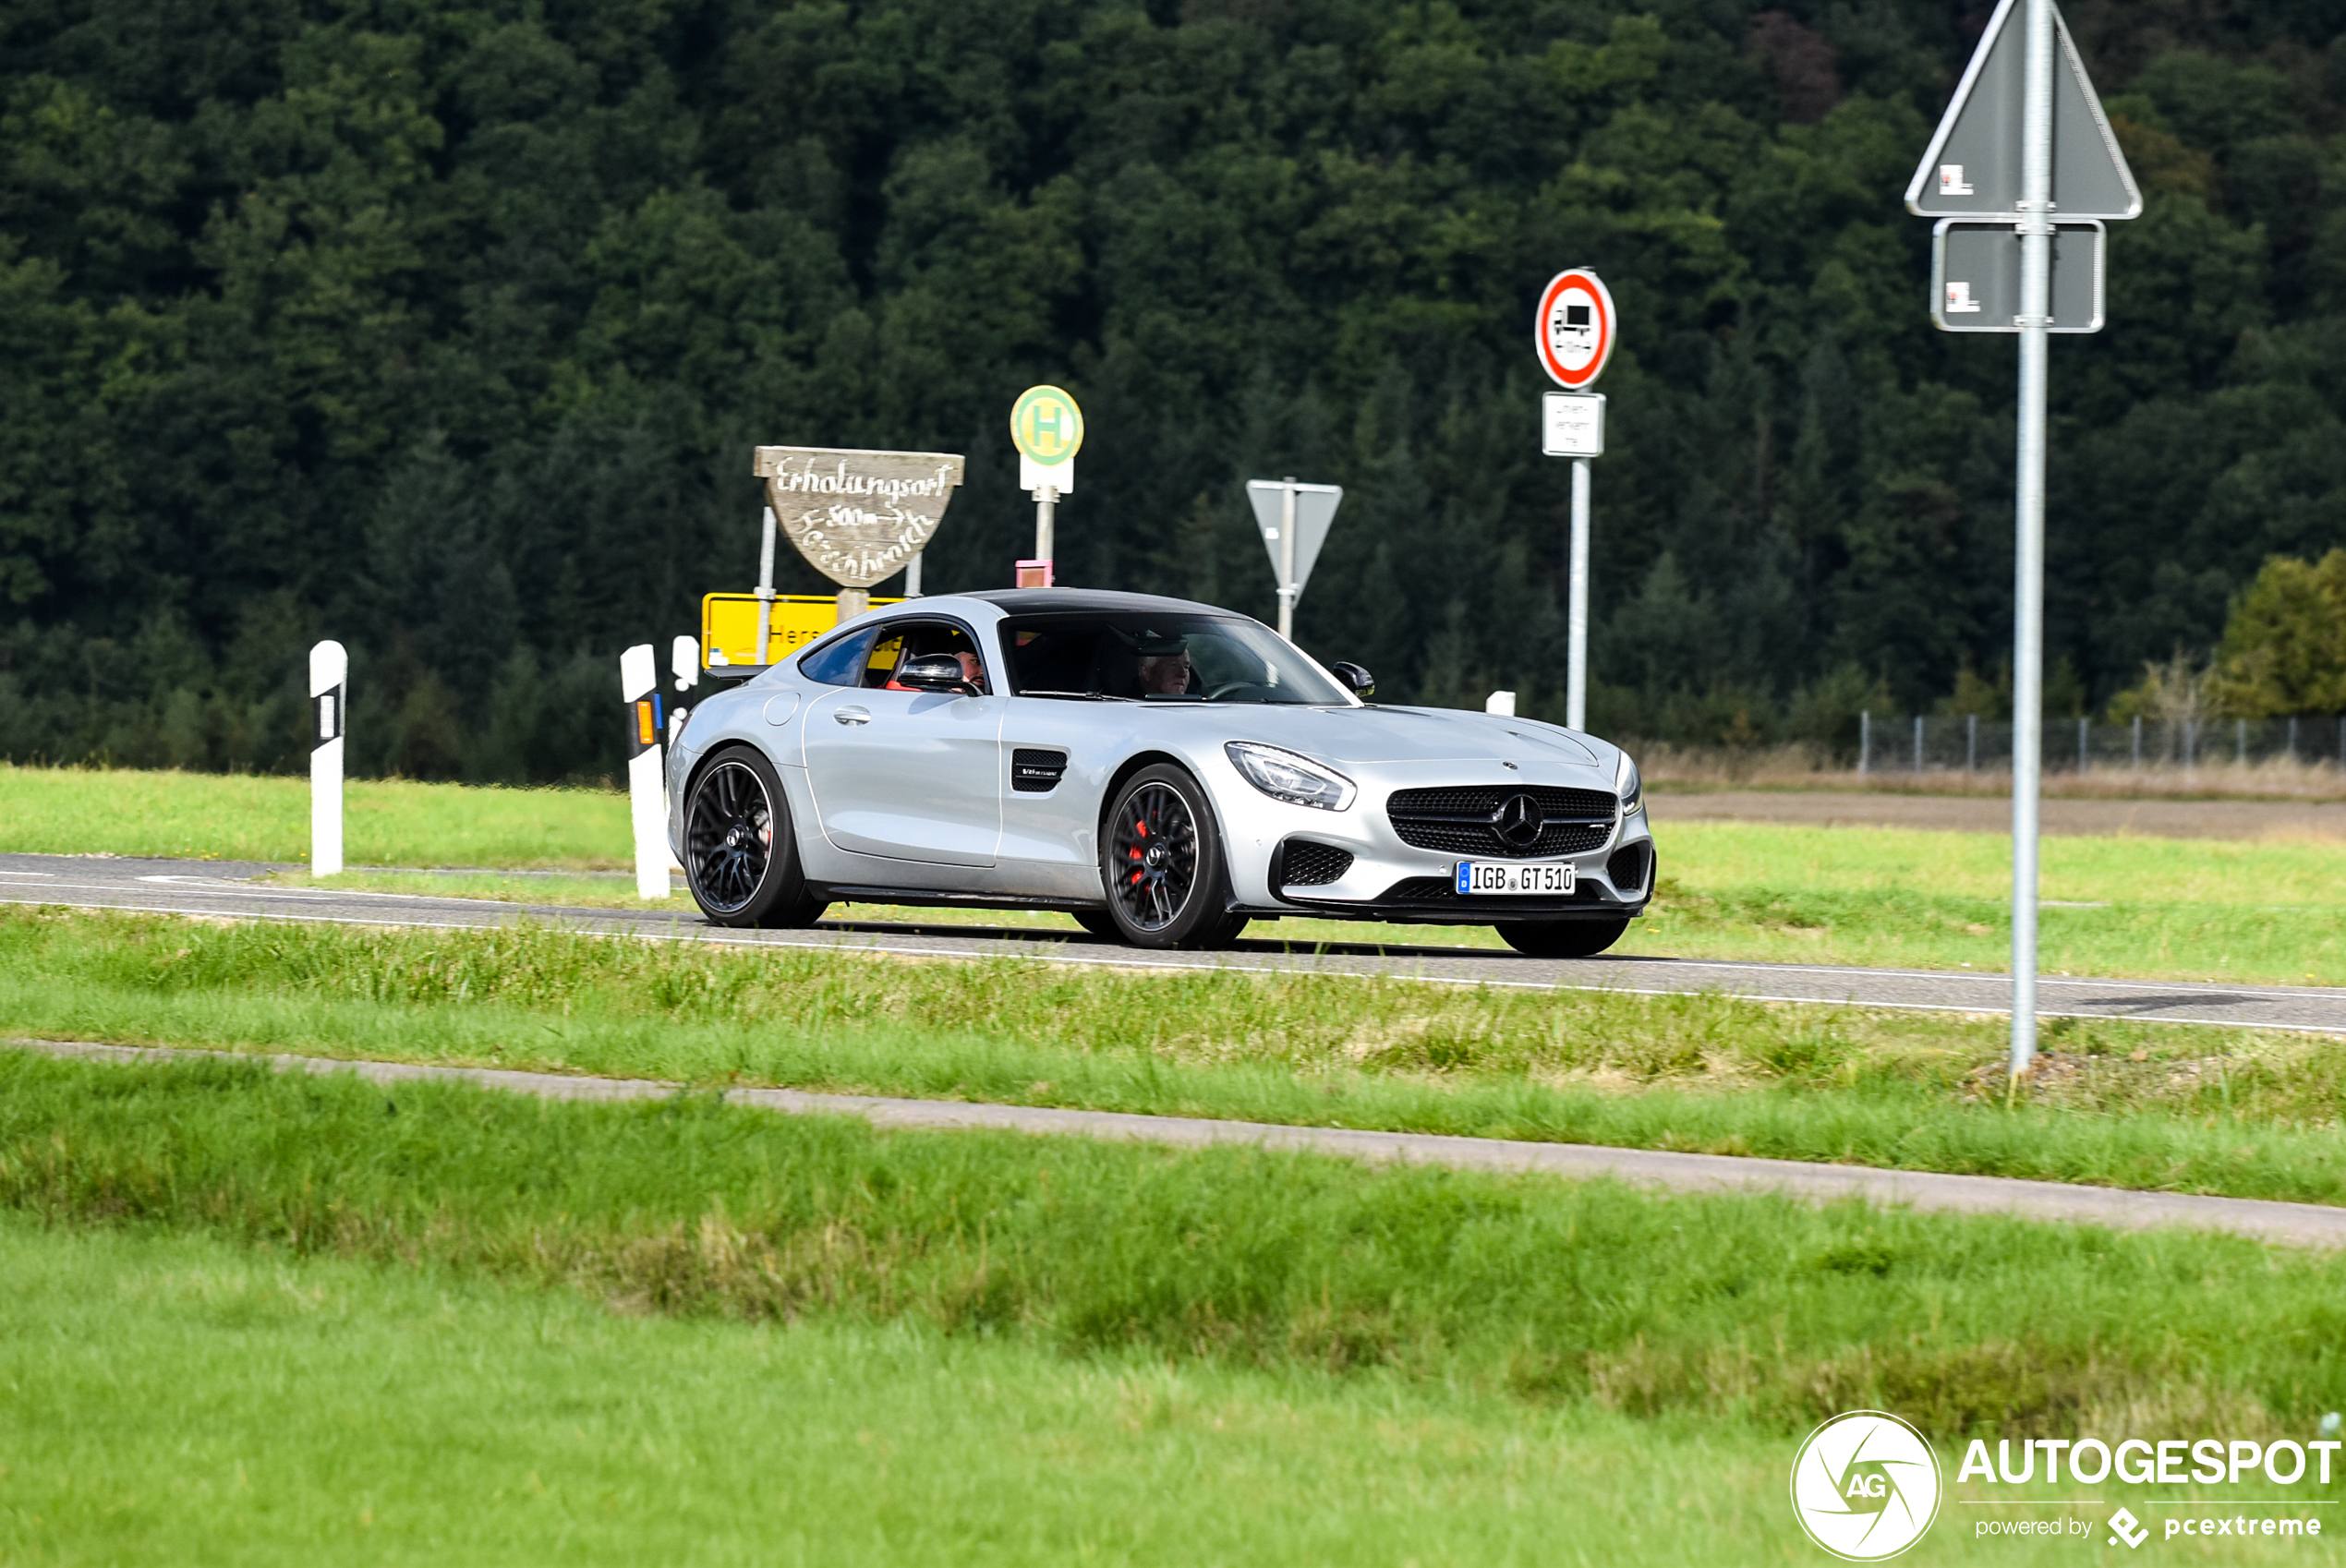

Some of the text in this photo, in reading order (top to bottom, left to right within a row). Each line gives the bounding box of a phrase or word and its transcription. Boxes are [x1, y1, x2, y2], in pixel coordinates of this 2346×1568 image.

[1033, 405, 1062, 449] H
[776, 456, 954, 509] Erholungsort
[1472, 867, 1506, 889] IGB
[1521, 867, 1542, 890] GT
[1544, 868, 1572, 890] 510
